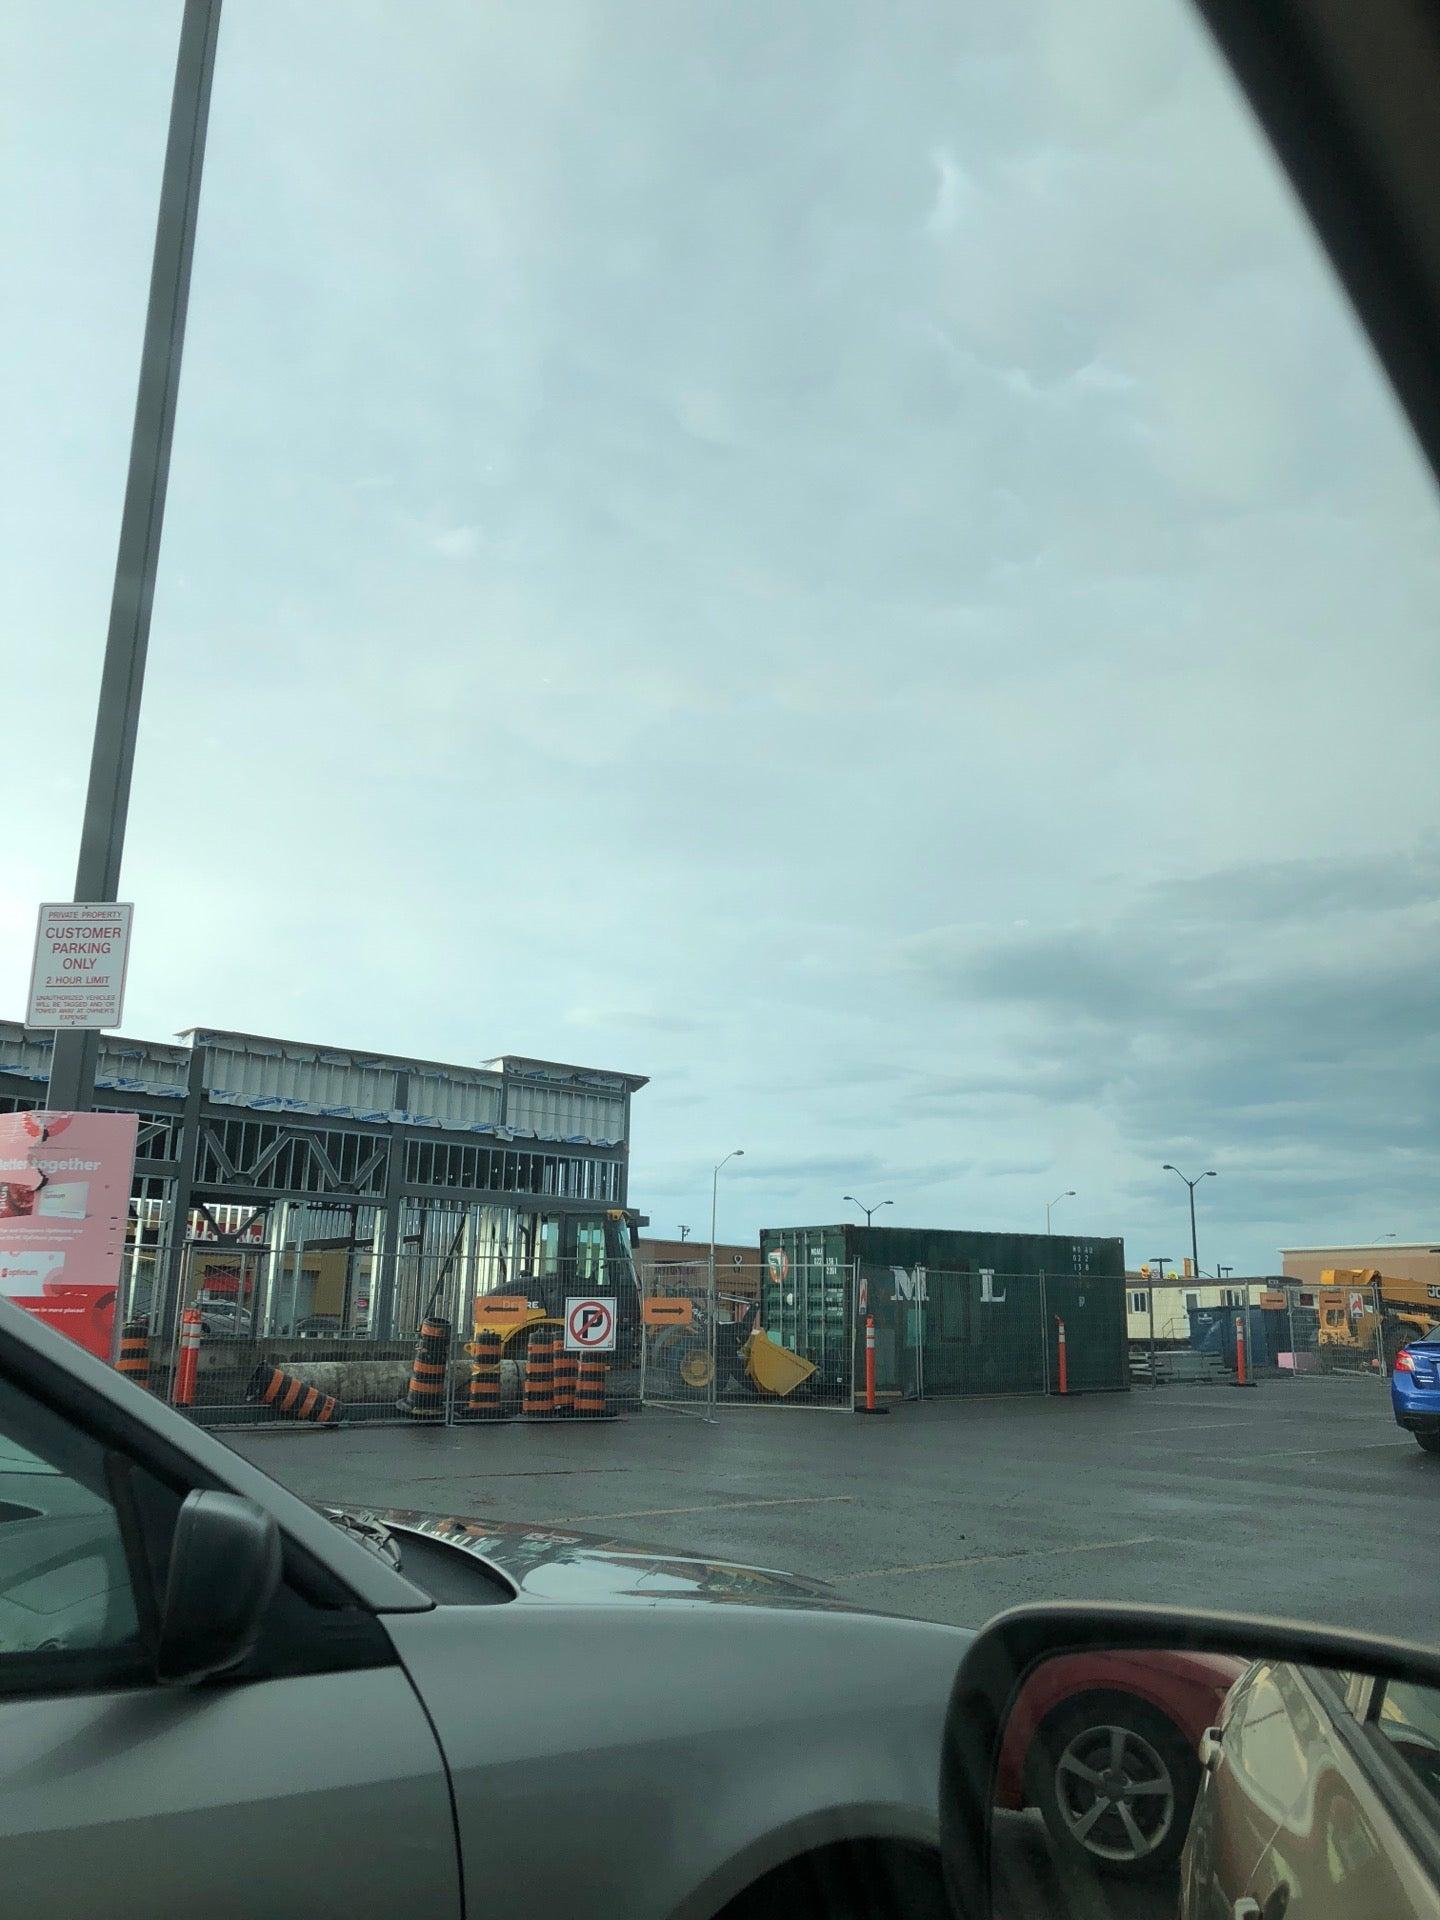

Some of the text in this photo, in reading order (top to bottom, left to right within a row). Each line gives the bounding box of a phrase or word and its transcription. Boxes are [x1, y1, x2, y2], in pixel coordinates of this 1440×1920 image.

[48, 911, 122, 919] PRIVATE PROPERTY
[45, 927, 121, 939] CUSTOMER
[52, 942, 111, 954] PARKING
[62, 958, 97, 970] ONLY
[46, 976, 110, 985] 2 HOUR LIMIT
[31, 1157, 101, 1174] together
[889, 1265, 1007, 1303] M L
[1428, 1285, 1440, 1298] JC
[502, 1300, 540, 1309] DERE
